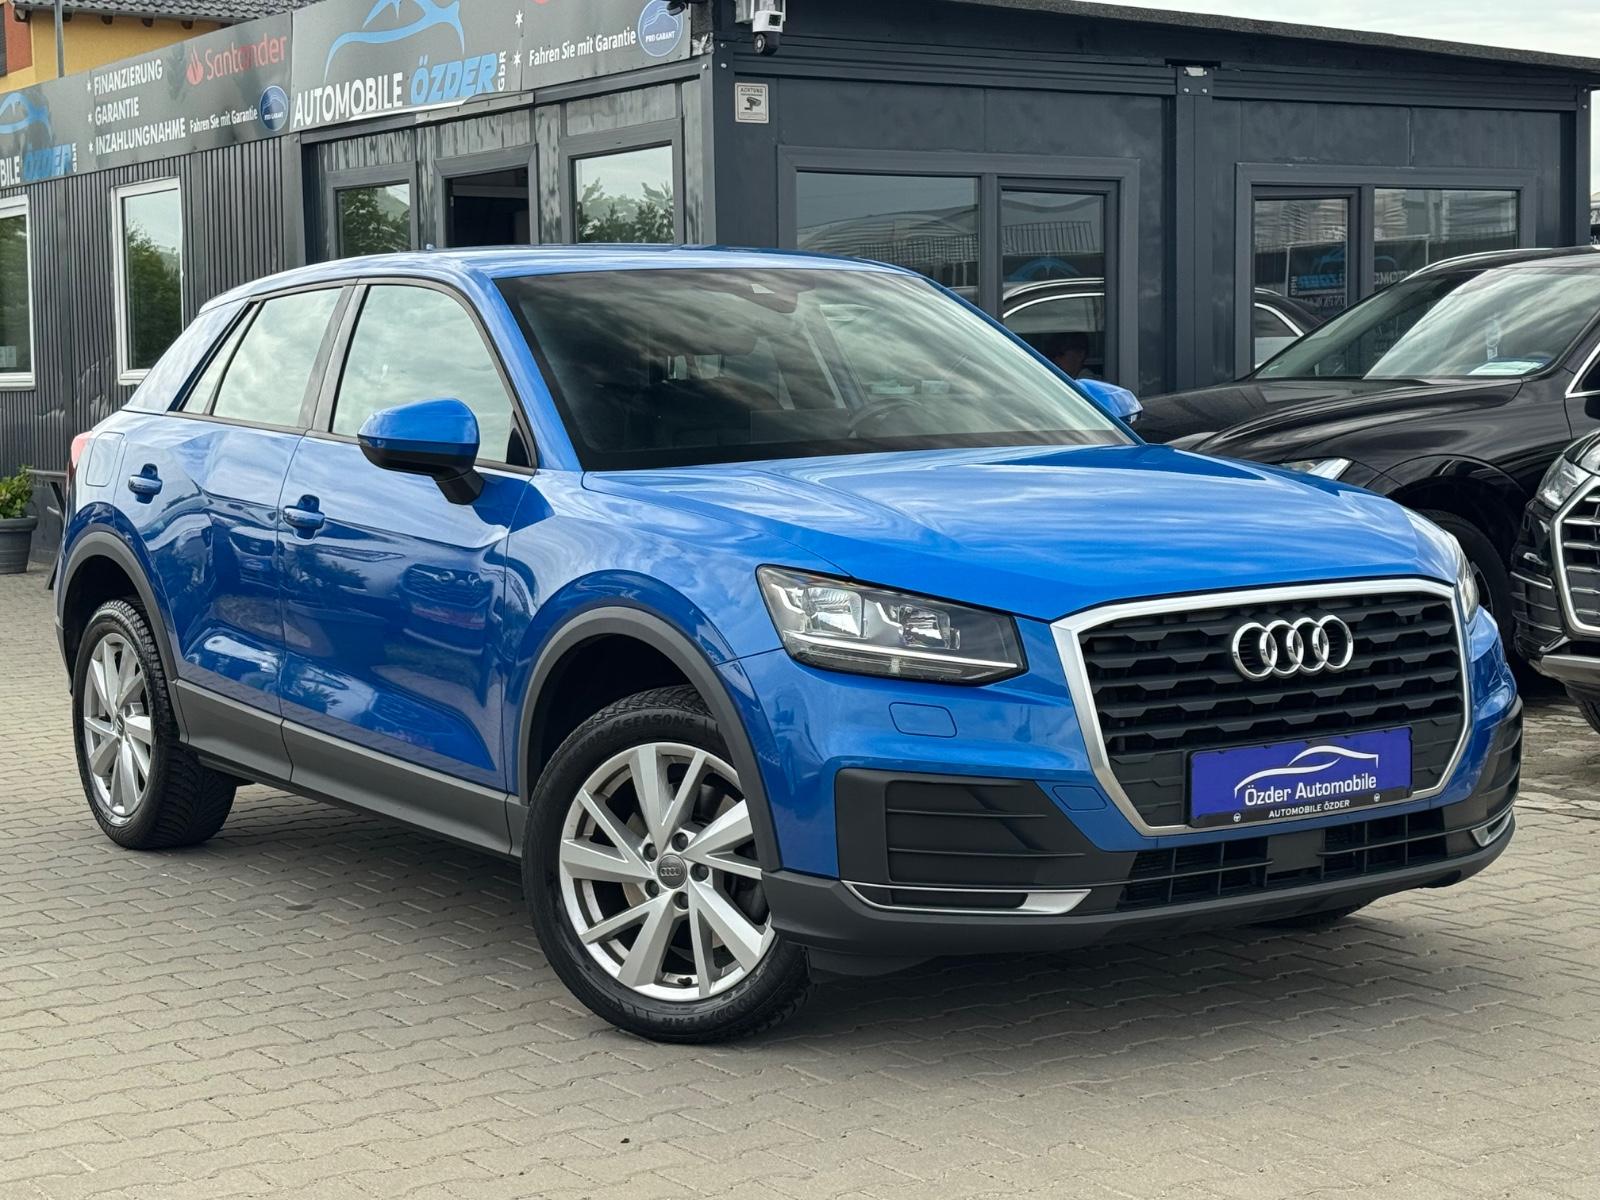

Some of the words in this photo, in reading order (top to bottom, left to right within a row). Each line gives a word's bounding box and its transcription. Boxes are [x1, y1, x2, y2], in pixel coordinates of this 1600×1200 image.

[529, 45, 561, 67] Fahren
[561, 40, 576, 59] Sie
[577, 35, 594, 56] mit
[595, 26, 637, 52] Garantie
[645, 34, 656, 43] PRO
[655, 30, 676, 41] GARANT
[205, 32, 287, 80] Santander
[497, 50, 507, 91] GbR
[94, 59, 163, 96] FINANZIERUNG
[293, 72, 403, 128] AUTOMOBILE
[410, 54, 497, 105] ÖZDER
[95, 96, 140, 126] GARANTIE
[189, 117, 210, 134] Fahren
[210, 113, 220, 129] Sie
[220, 110, 231, 127] mit
[231, 105, 258, 125] Garantie
[95, 117, 186, 156] INZAHLUNGNAHME
[1245, 785, 1291, 806] Özder
[1295, 773, 1377, 800] Automobile
[1268, 804, 1322, 818] AUTOMOBILE
[1323, 799, 1350, 811] ÖZDER
